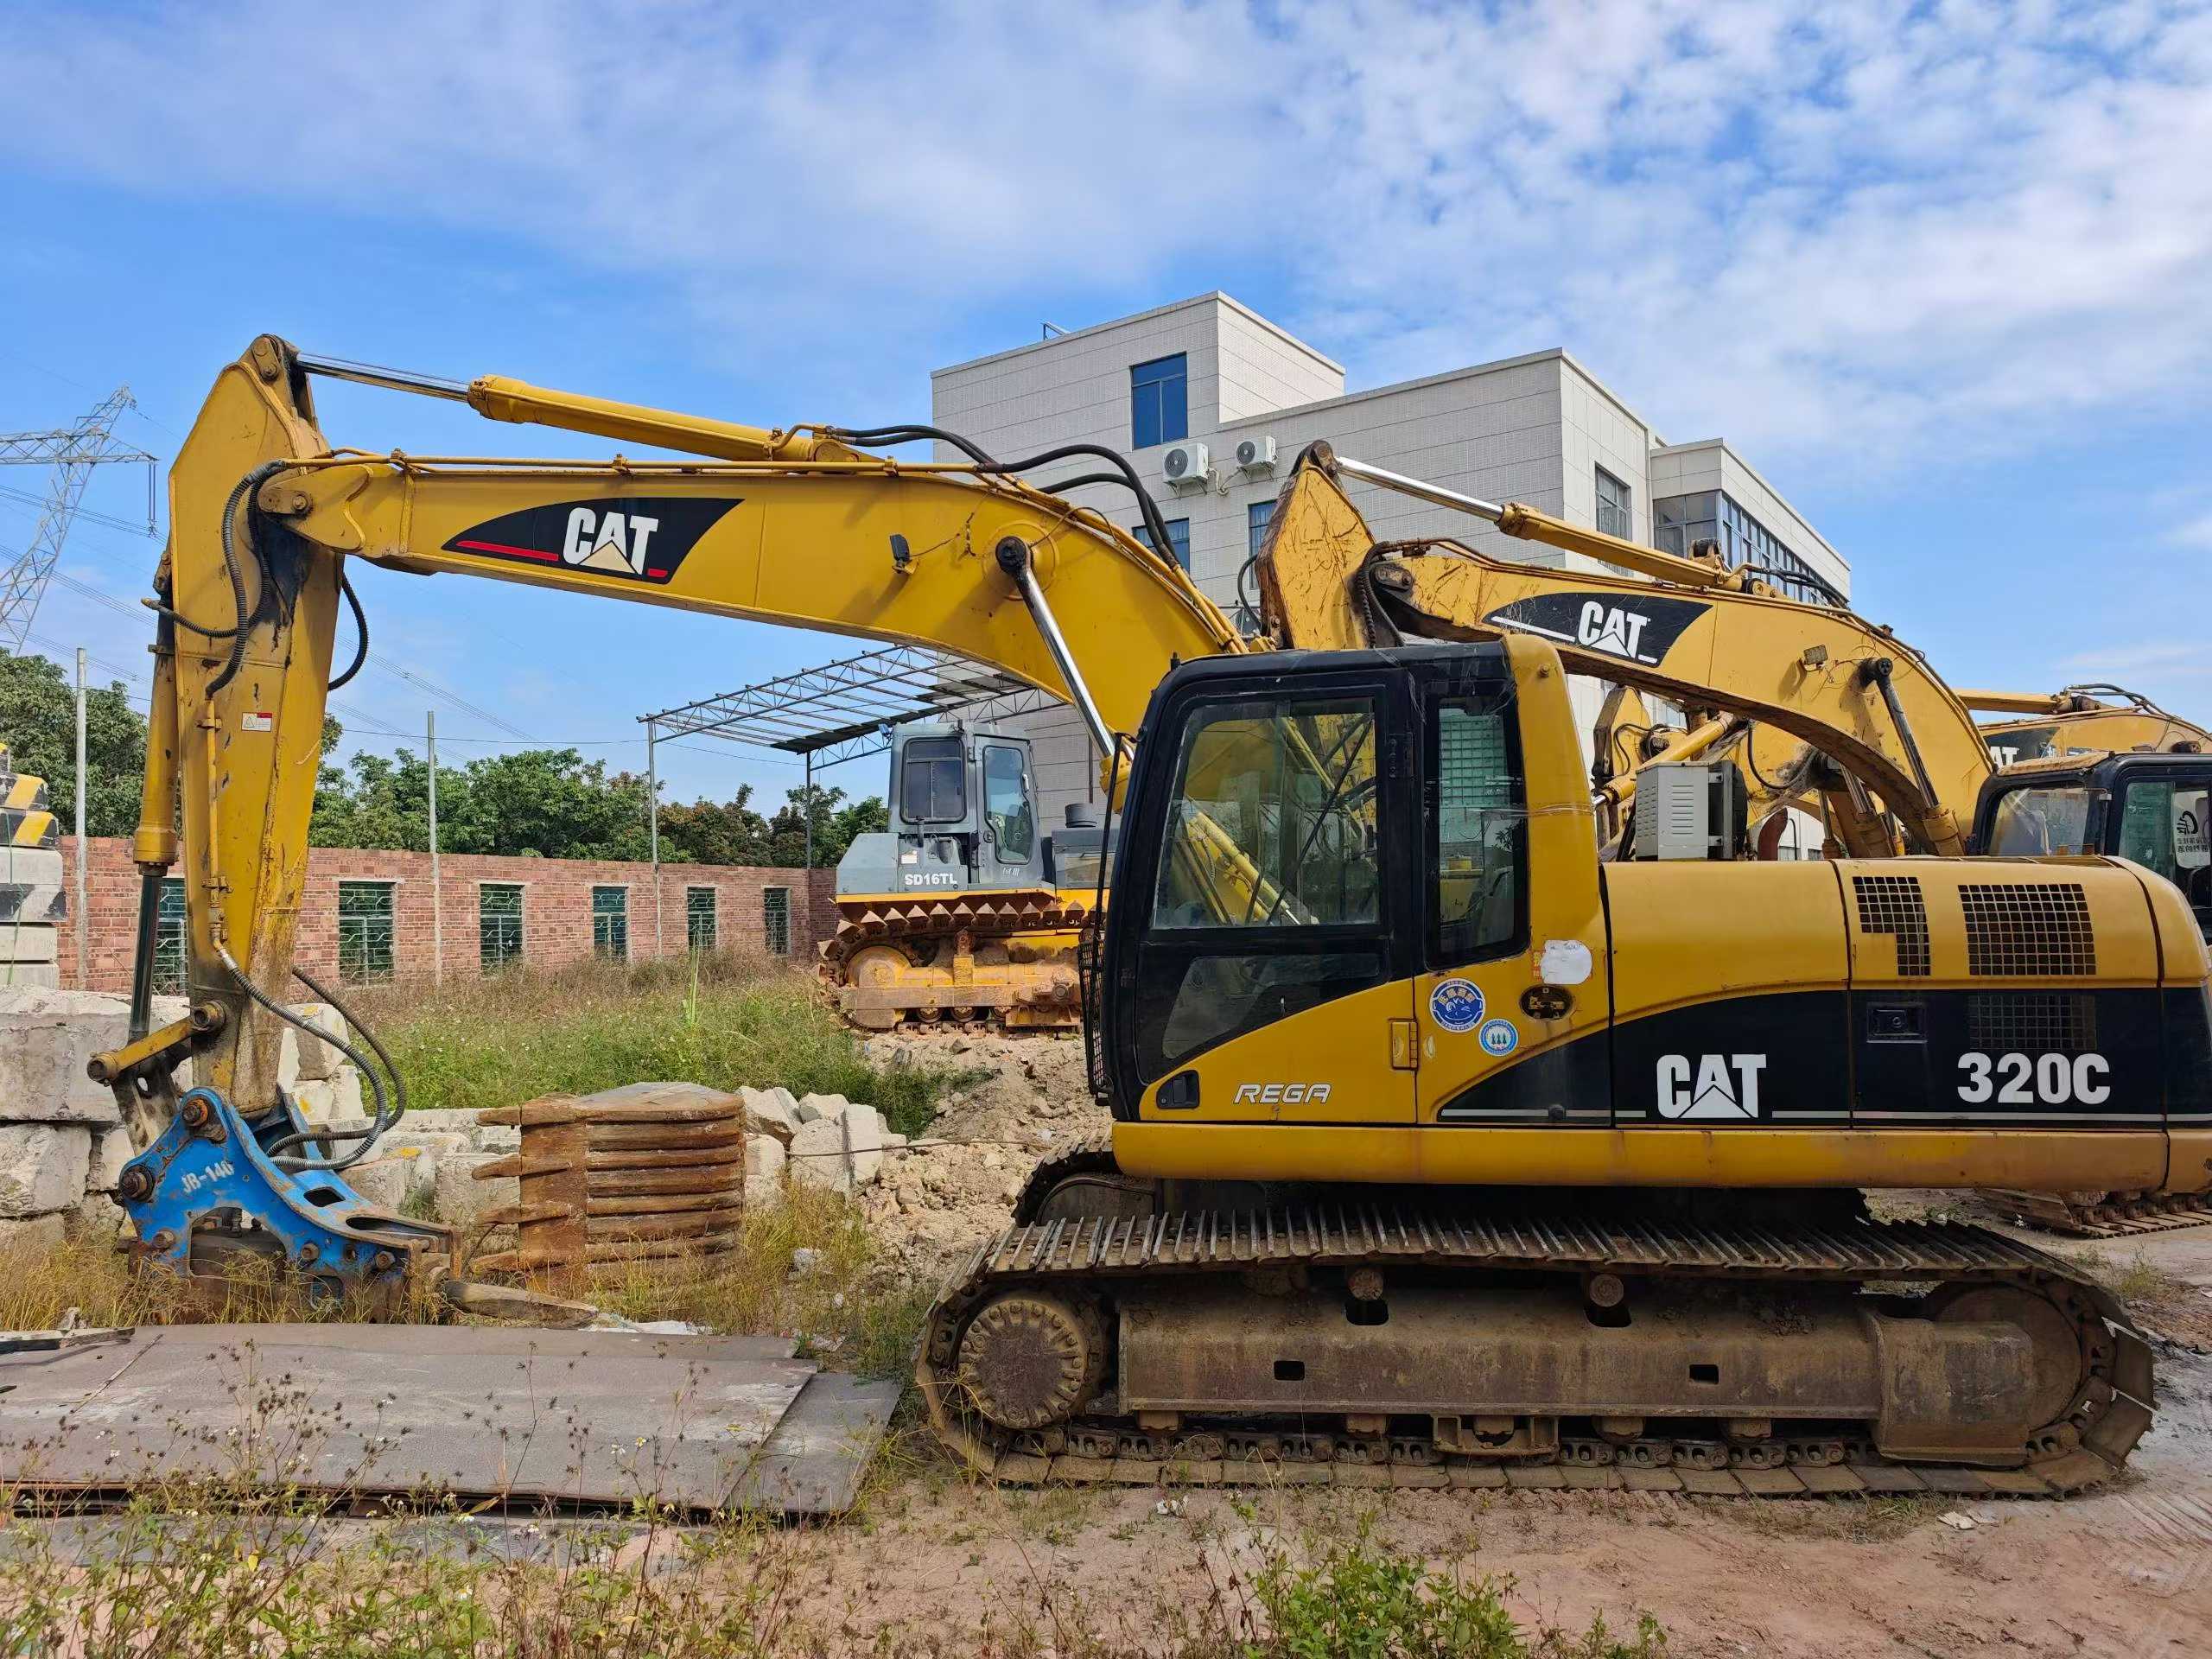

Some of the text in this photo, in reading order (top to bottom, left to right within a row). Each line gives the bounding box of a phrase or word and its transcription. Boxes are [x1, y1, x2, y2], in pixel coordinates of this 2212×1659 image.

[563, 506, 659, 575] CAT
[1578, 601, 1649, 658] CAT
[1989, 746, 2019, 770] AT
[904, 873, 957, 886] SD16TL
[1232, 1083, 1332, 1103] REGA
[1656, 1053, 1767, 1119] CAT
[1957, 1052, 2111, 1104] 320C
